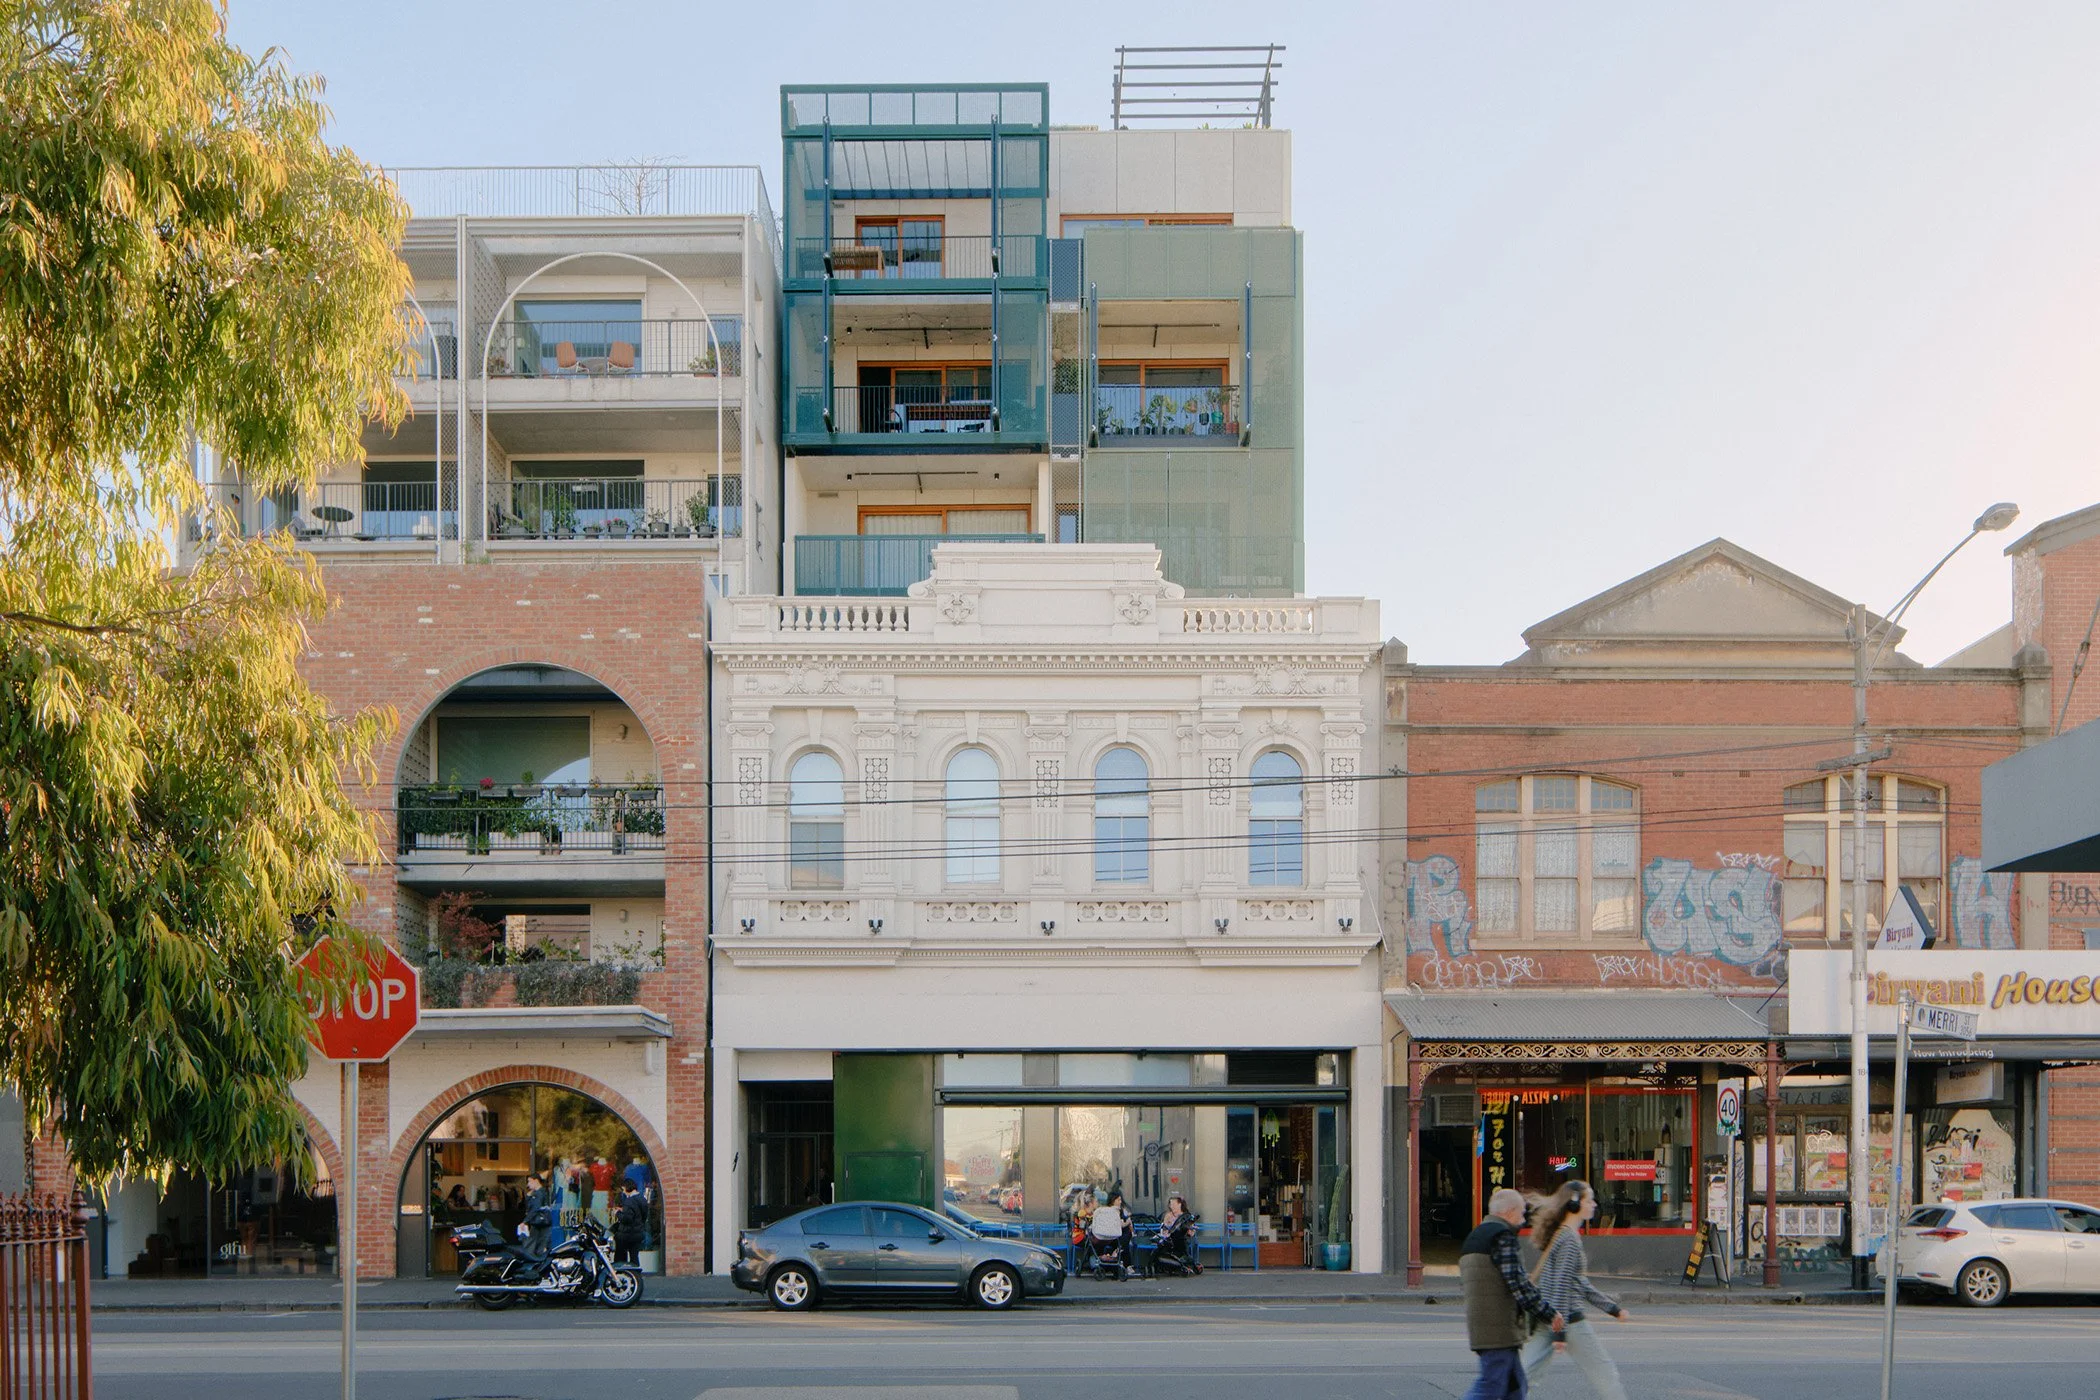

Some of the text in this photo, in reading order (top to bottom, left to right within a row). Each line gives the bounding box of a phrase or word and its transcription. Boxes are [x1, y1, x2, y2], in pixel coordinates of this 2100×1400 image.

[1886, 923, 1914, 943] Biryani
[1928, 1009, 1971, 1032] MERRI ST
[1721, 1098, 1736, 1117] 40
